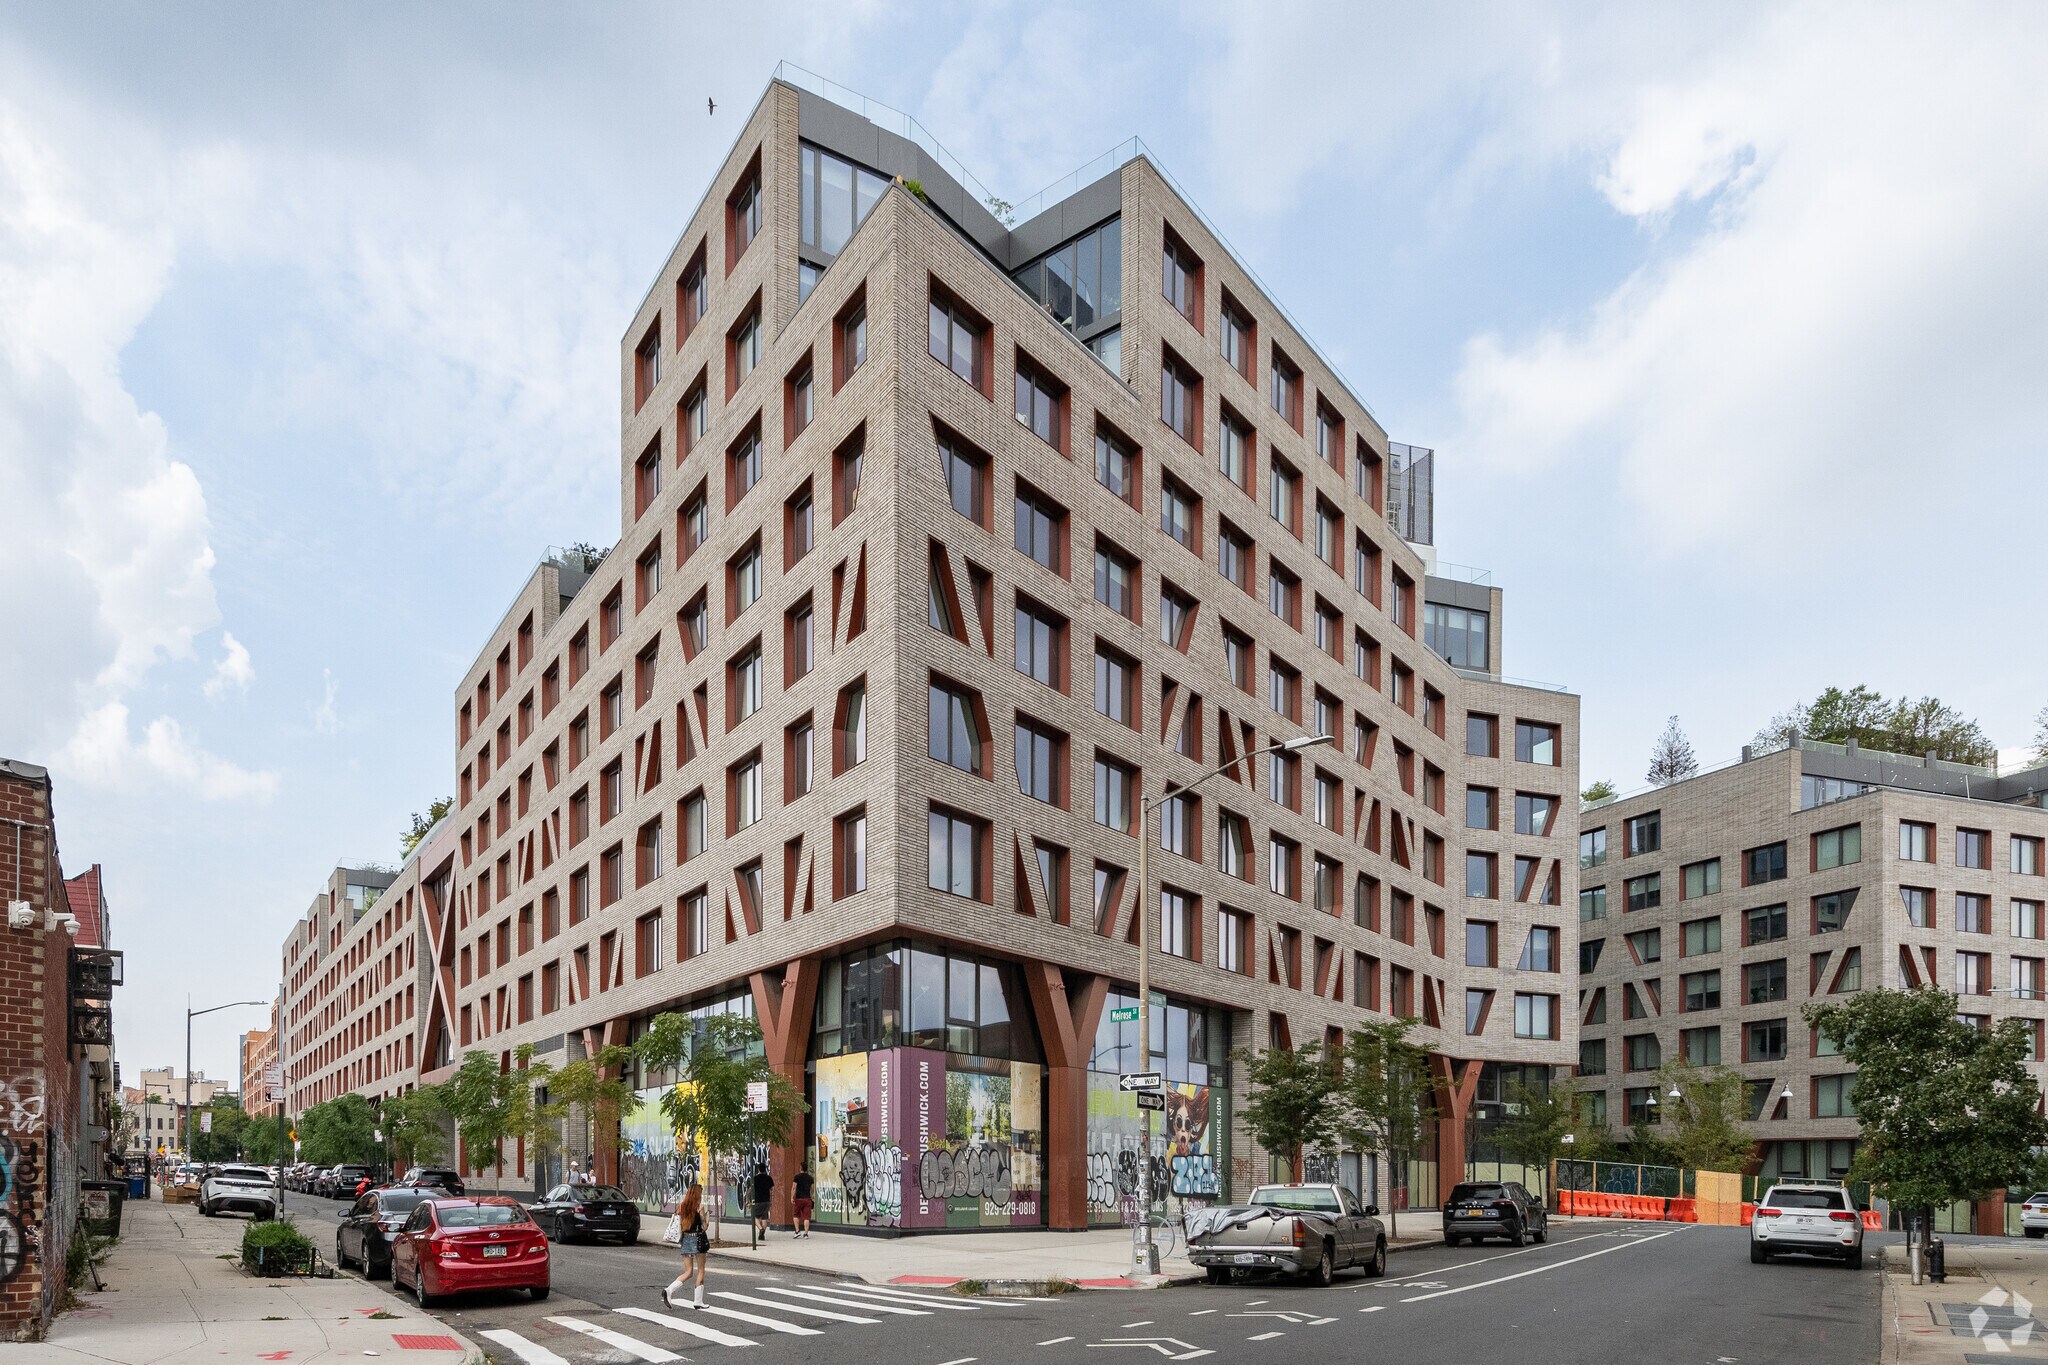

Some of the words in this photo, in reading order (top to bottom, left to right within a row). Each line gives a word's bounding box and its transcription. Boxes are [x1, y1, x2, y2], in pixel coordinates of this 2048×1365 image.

[1112, 1010, 1132, 1021] Melrose
[1123, 1079, 1137, 1087] ONE
[1140, 1096, 1150, 1104] ONE
[1152, 1098, 1161, 1107] WAY
[984, 1201, 1036, 1216] 929-229-0818
